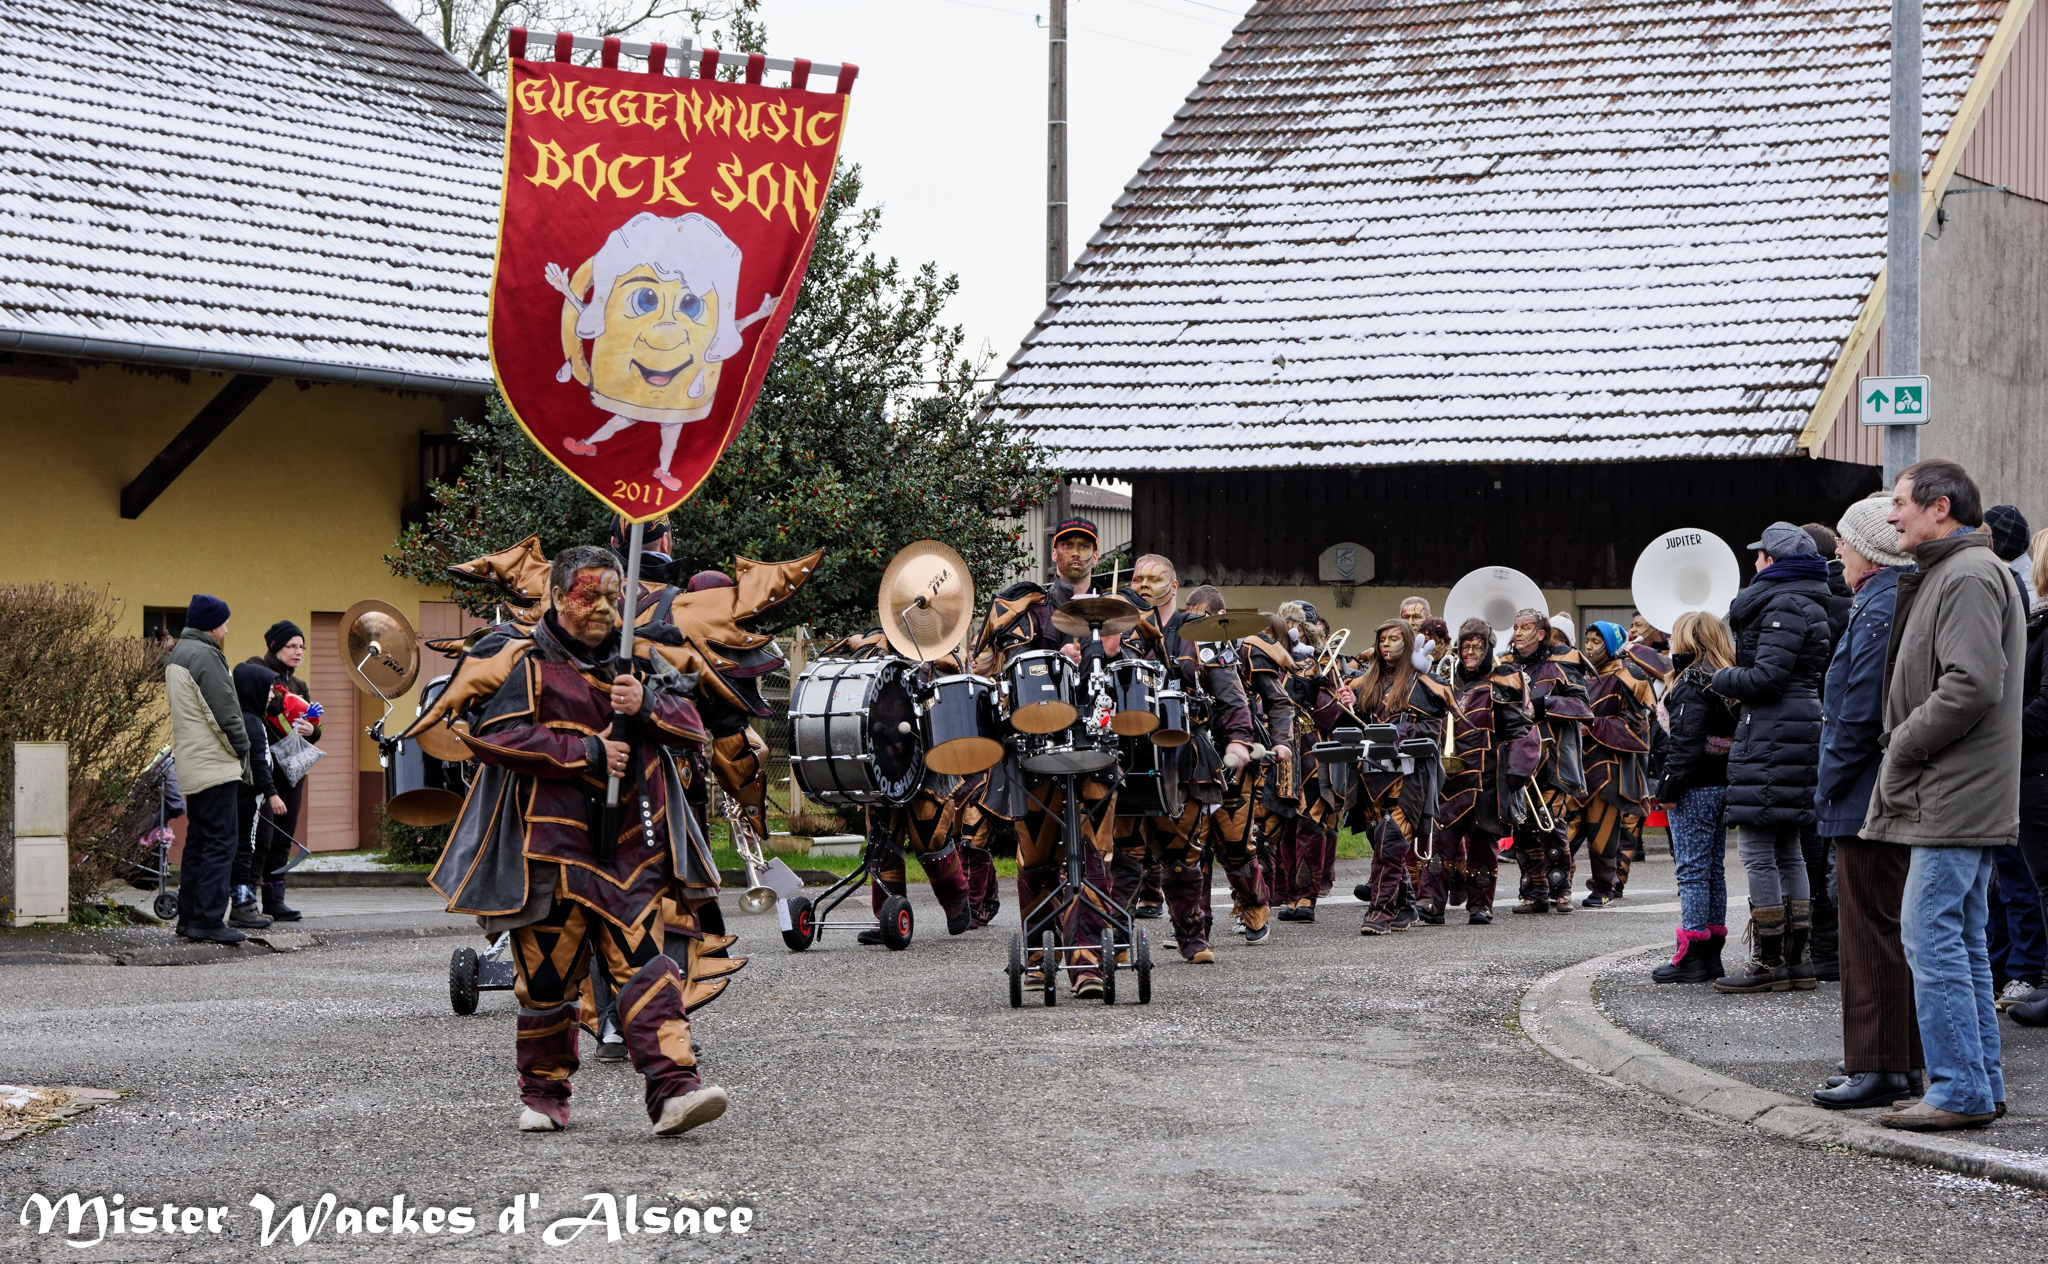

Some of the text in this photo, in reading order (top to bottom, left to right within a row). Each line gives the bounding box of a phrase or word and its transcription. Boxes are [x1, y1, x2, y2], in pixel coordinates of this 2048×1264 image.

[515, 73, 839, 148] GUGGENMUSIC
[523, 135, 819, 234] BOCK SON
[612, 479, 663, 506] 2011
[1666, 533, 1702, 549] JUPITER
